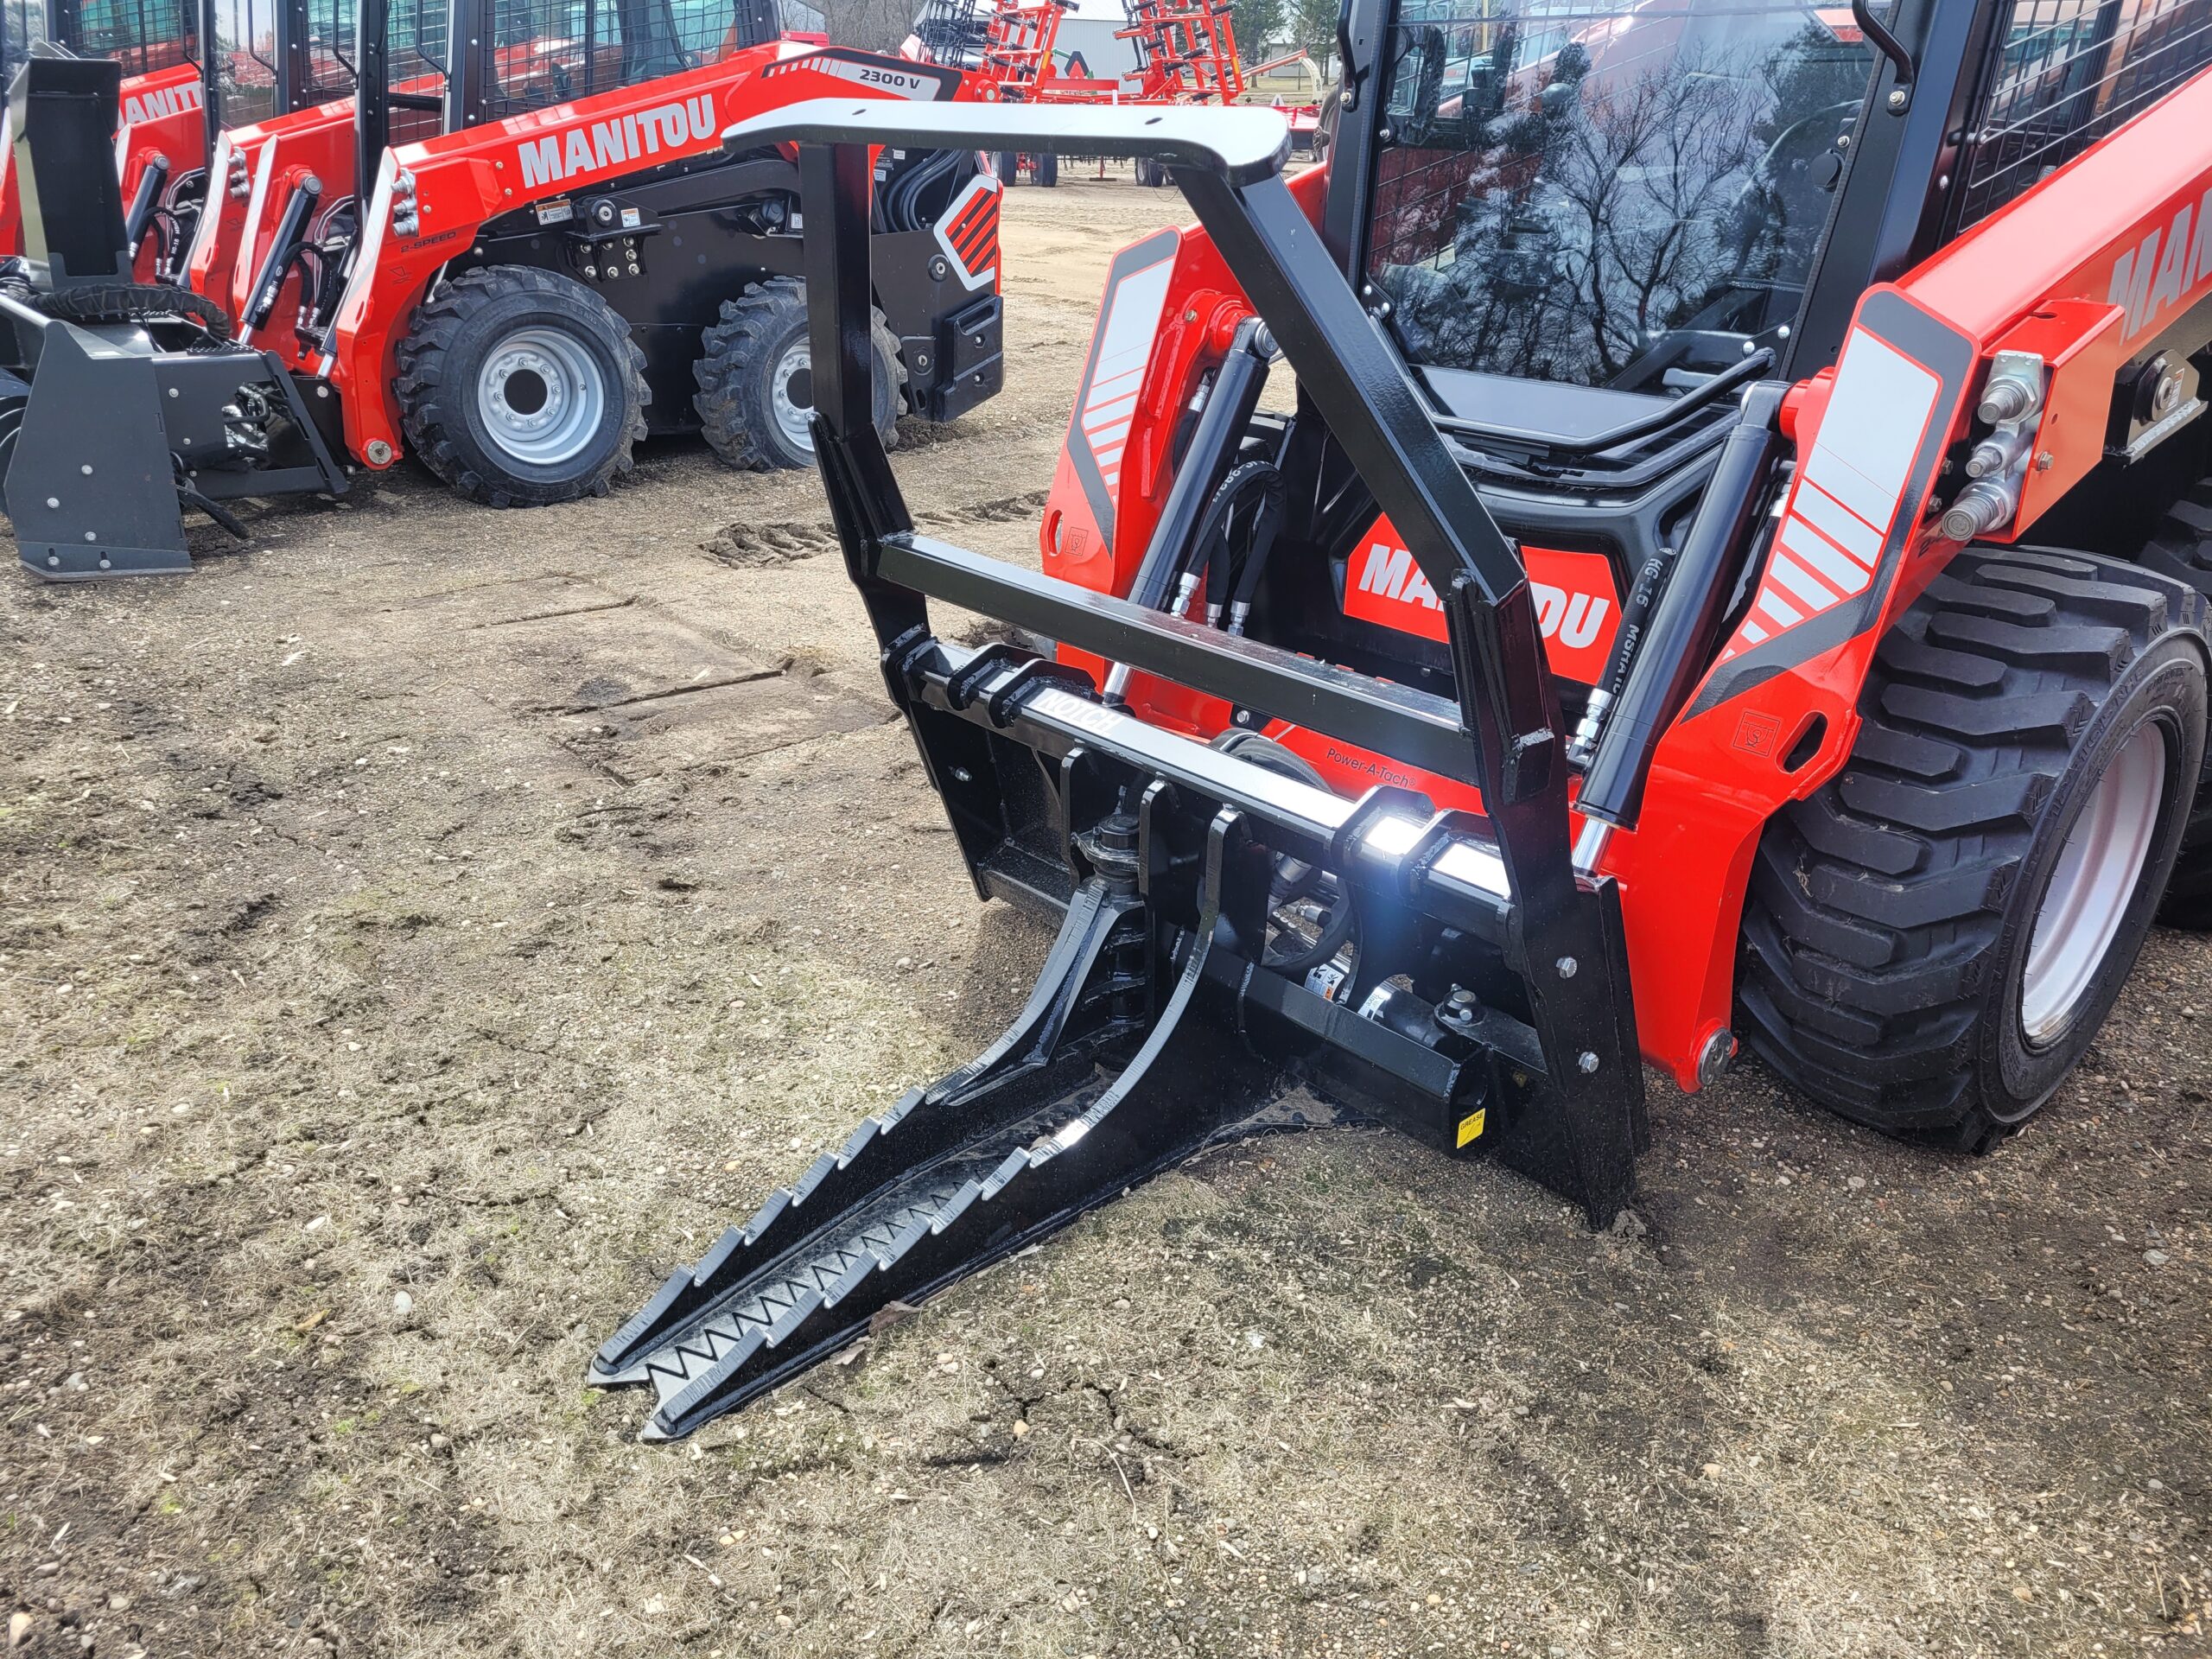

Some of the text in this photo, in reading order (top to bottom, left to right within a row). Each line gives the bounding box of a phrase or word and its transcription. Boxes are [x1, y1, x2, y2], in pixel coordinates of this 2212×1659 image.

[859, 68, 921, 90] 2300 V
[118, 80, 203, 130] ANIT
[518, 92, 716, 189] MANITOU
[400, 231, 456, 252] 2-SPEED
[1357, 543, 1611, 649] MAOU
[1636, 556, 1663, 608] HG-16
[1034, 691, 1125, 732] NOTCH
[1460, 1112, 1484, 1129] GREASE
